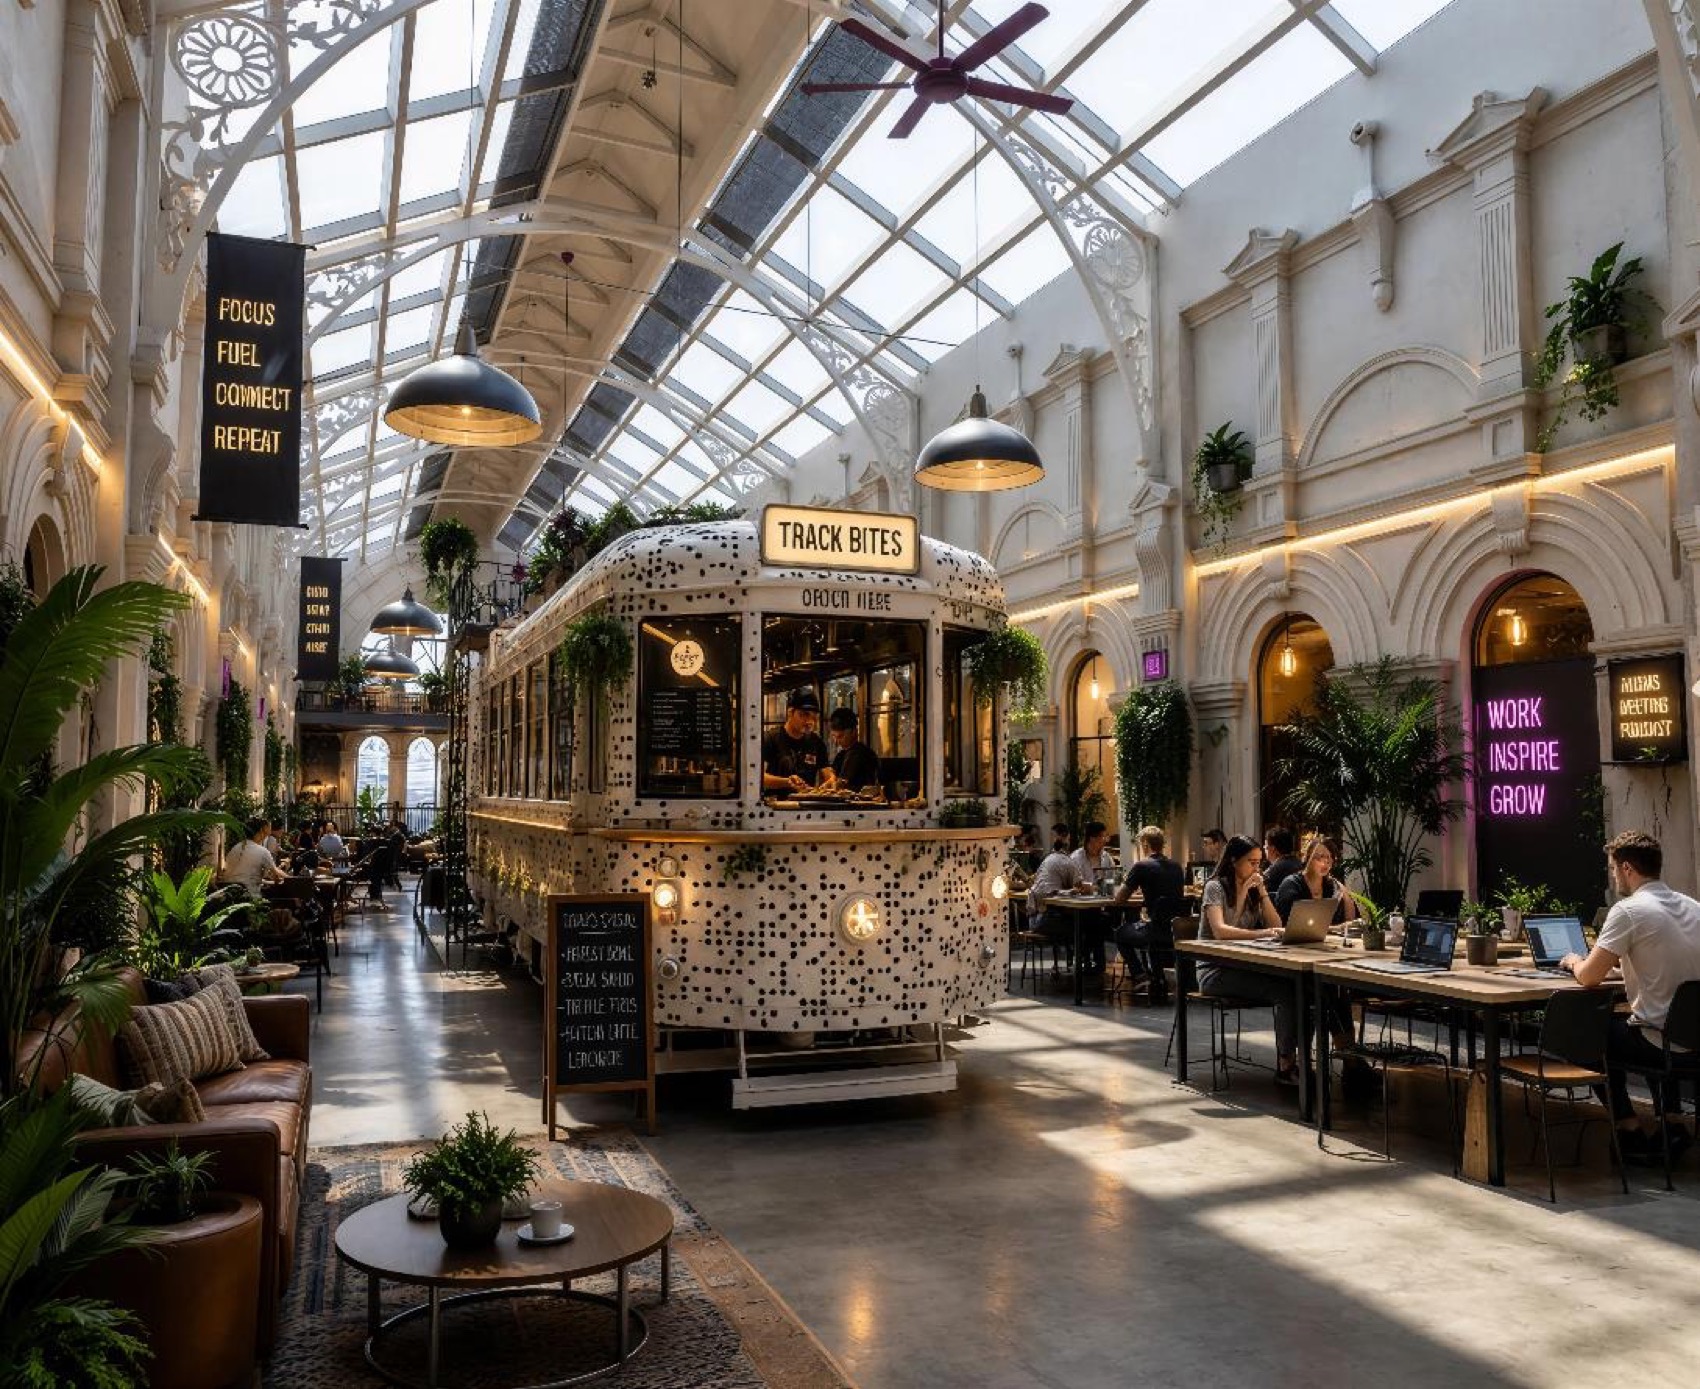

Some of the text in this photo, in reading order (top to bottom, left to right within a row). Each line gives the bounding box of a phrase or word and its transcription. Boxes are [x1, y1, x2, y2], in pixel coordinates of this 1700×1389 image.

[219, 297, 276, 326] FOCUS
[217, 340, 262, 368] FUEL
[213, 424, 282, 455] REPEAT
[778, 521, 903, 557] TRACK BITES
[1487, 697, 1543, 729] WORK
[1490, 740, 1561, 773] INSPIRE
[1490, 784, 1546, 815] GROW
